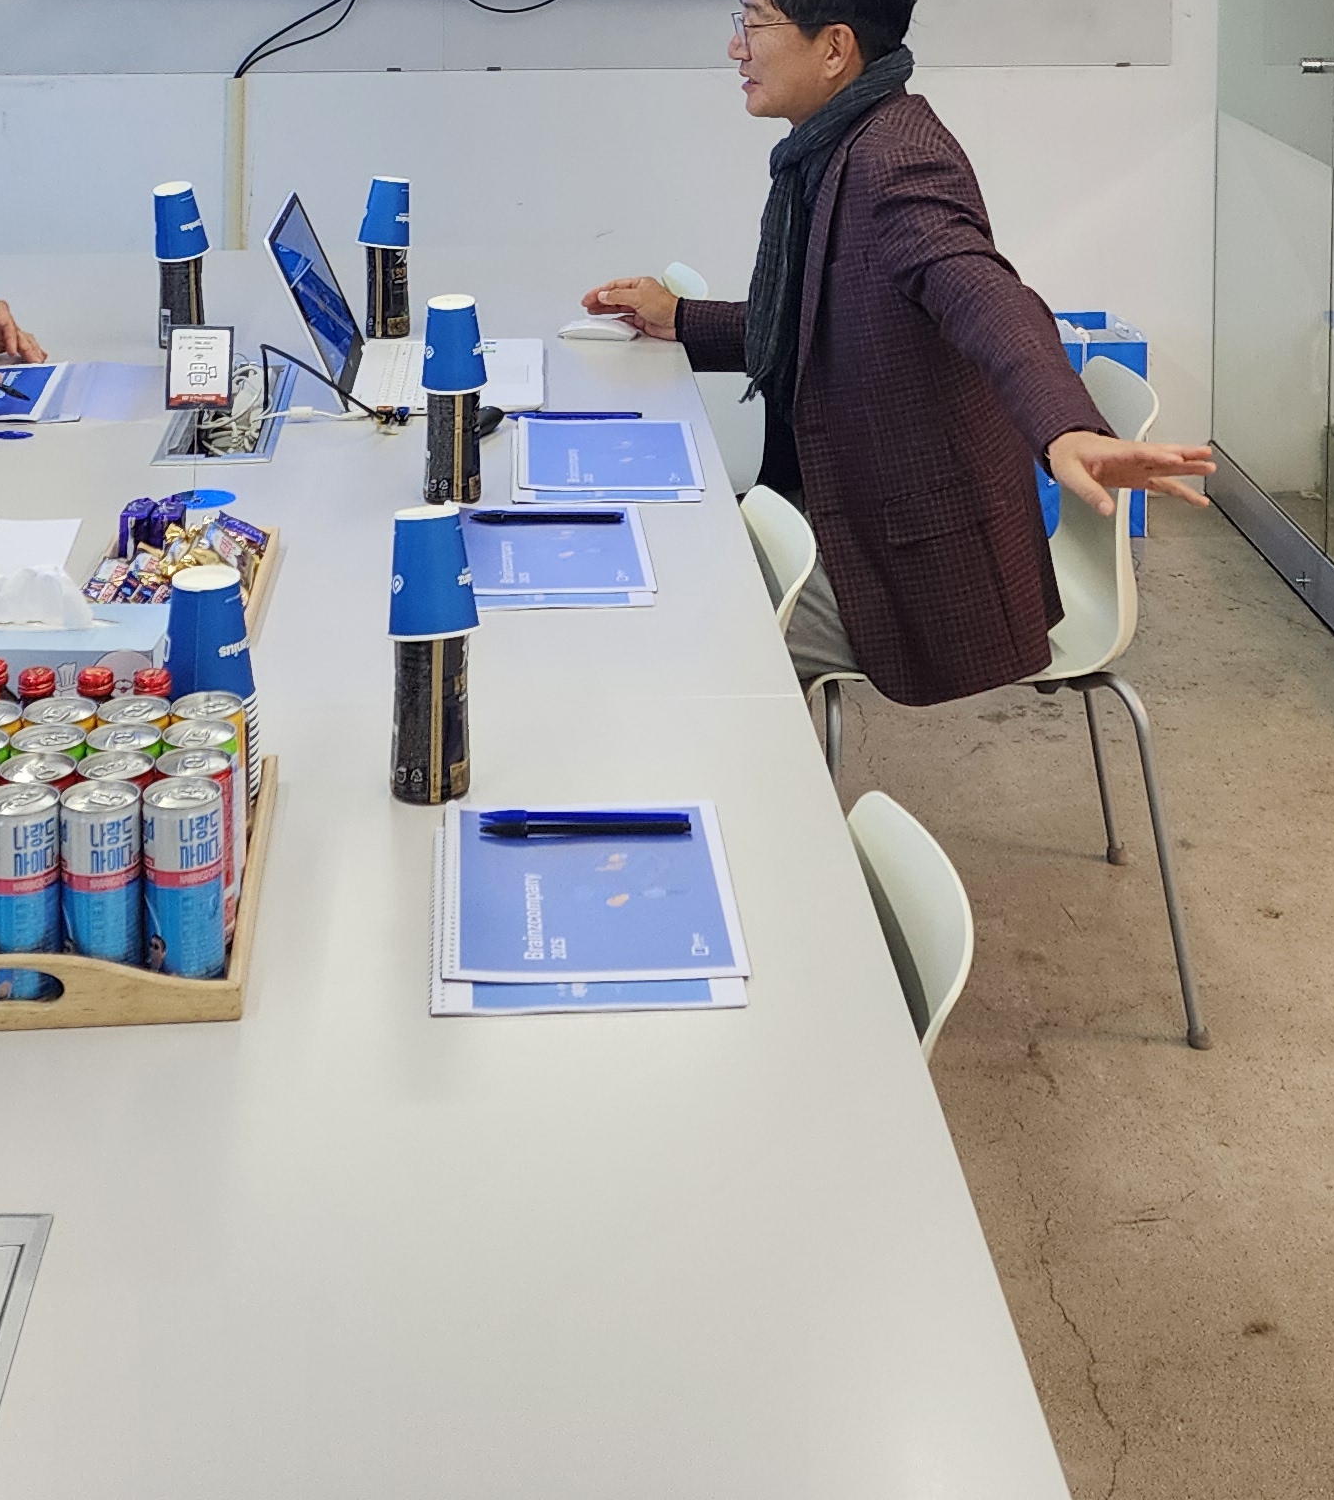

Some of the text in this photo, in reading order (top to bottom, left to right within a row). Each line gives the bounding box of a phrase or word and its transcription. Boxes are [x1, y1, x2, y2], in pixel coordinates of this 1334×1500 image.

[13, 817, 55, 850] 나랑드
[90, 815, 133, 847] 나랑드
[179, 809, 220, 842] 나랑드
[523, 873, 544, 960] Brainzcompany
